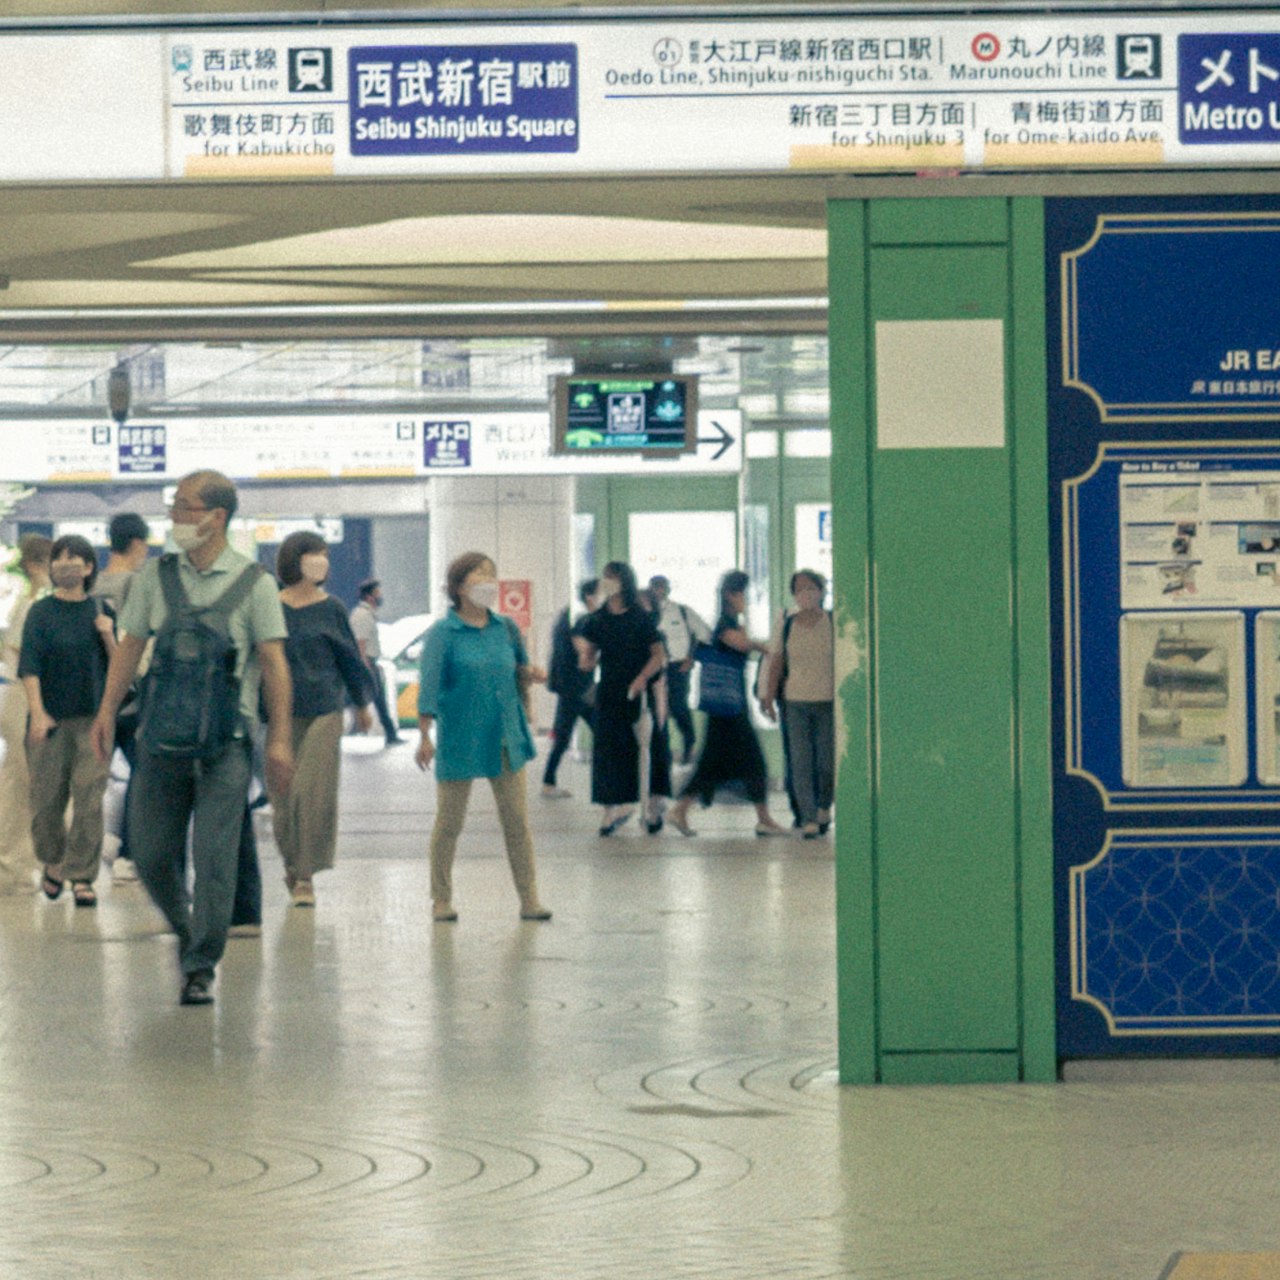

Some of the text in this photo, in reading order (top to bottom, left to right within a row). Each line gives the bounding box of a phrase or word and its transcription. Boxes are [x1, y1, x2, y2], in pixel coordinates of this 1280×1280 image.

[704, 38, 932, 62] 大江戸線新宿西口駅
[1008, 34, 1107, 59] 丸ノ内線
[203, 49, 278, 71] 西武線
[950, 62, 1107, 79] Marunouchi Line
[182, 75, 279, 92] Seibu Line
[606, 64, 933, 87] Oedo Line, Shinjuku-nishiguchi Sta.
[789, 102, 965, 127] 新宿三丁目方面
[1011, 98, 1163, 123] 青梅街道方面
[1184, 102, 1263, 130] Metro
[183, 112, 335, 135] 歌舞伎町方面
[355, 115, 577, 144] Seibu Shinjuku Square
[203, 138, 336, 156] for Kabukicho
[832, 130, 965, 150] for Shinjuku 3
[984, 128, 1009, 144] for
[1017, 127, 1120, 143] Ome-kaido
[1220, 350, 1251, 371] JR
